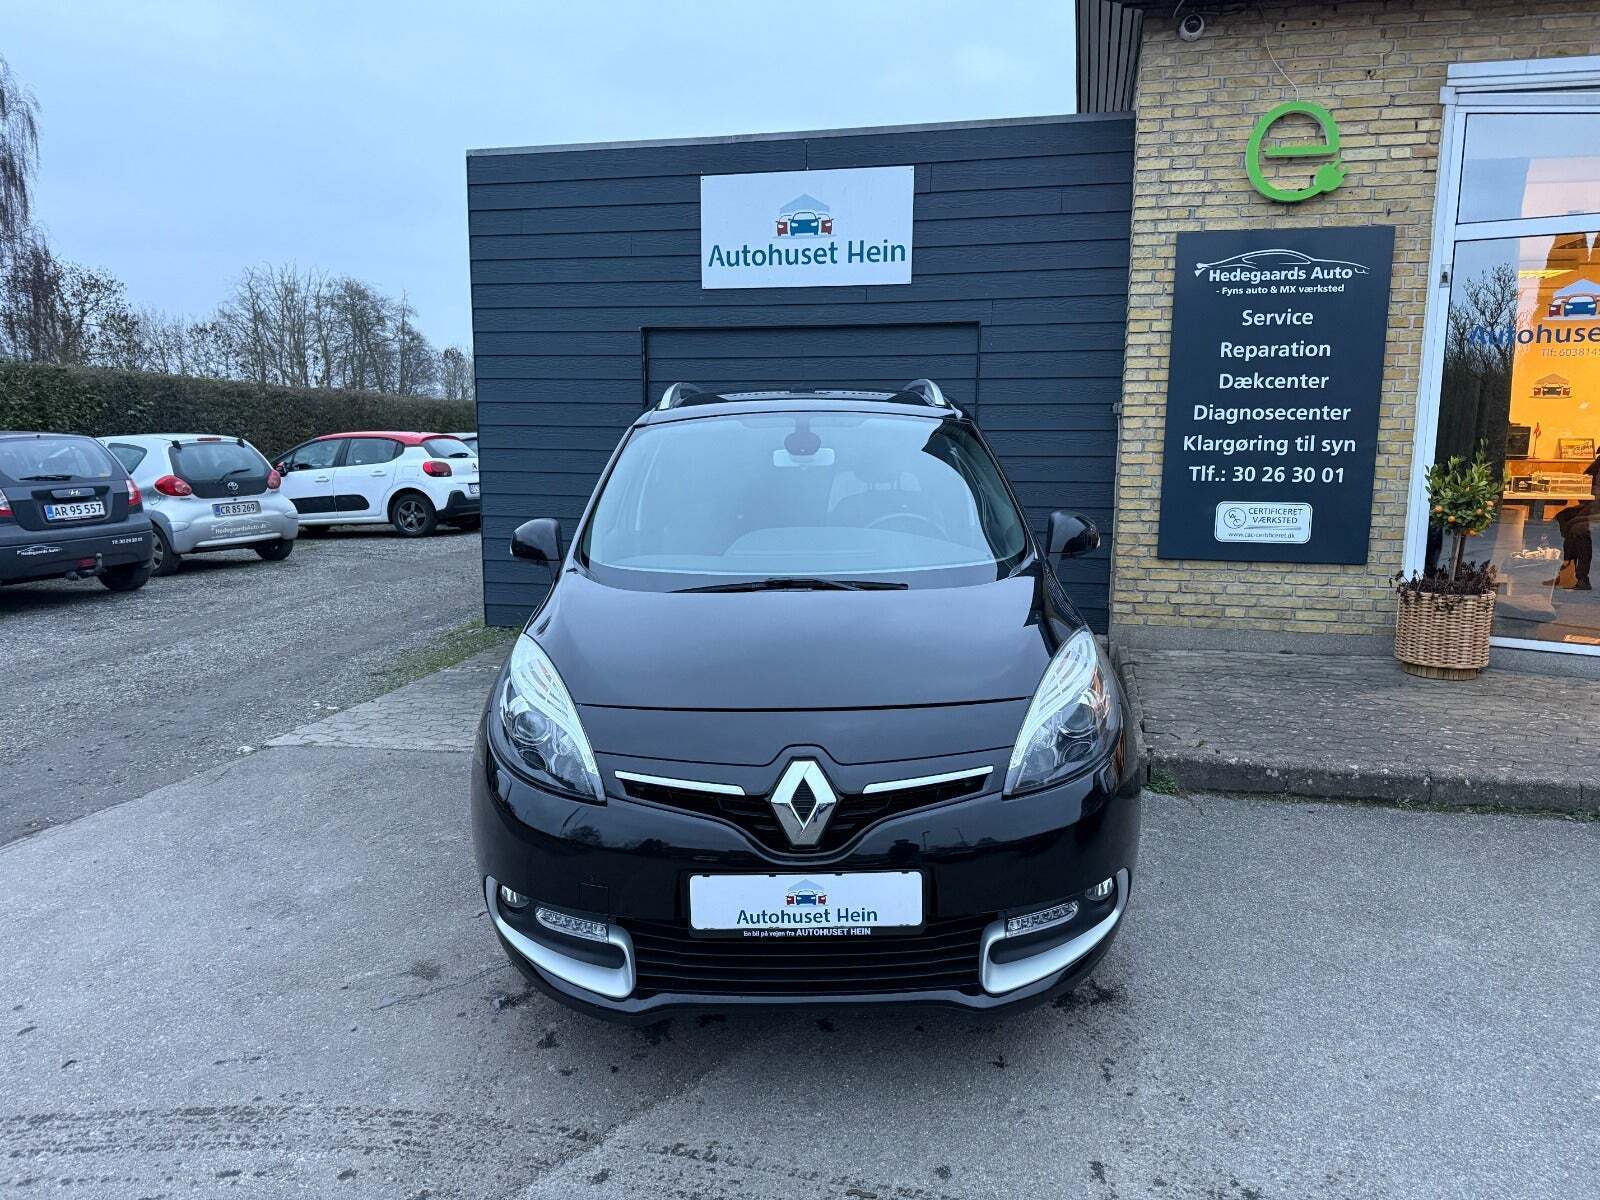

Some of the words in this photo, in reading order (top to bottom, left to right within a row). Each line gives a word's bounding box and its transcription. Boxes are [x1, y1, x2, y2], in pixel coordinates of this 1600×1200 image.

[708, 241, 838, 267] Autohuset
[848, 239, 906, 264] Hein
[1209, 266, 1306, 284] Hedegaards
[1311, 266, 1353, 280] Auto
[1222, 286, 1243, 296] Fyns
[1246, 286, 1268, 294] auto
[1270, 286, 1278, 294] &
[1280, 285, 1296, 293] MX
[1299, 284, 1344, 293] værksted
[1242, 308, 1314, 326] Service
[1220, 340, 1331, 361] Reparation
[1219, 372, 1330, 389] Dækcenter
[1193, 404, 1352, 424] Diagnosecenter
[1183, 435, 1289, 455] Klargøring
[1295, 436, 1315, 452] til
[1321, 438, 1356, 455] syn
[1189, 465, 1226, 482] Tlf.:
[1232, 466, 1256, 482] 30
[1261, 467, 1285, 483] 26
[1291, 467, 1315, 483] 30
[1321, 467, 1344, 483] 01
[55, 506, 68, 516] AR
[70, 505, 82, 515] 95
[84, 503, 102, 514] 557
[220, 506, 231, 515] CR
[1248, 507, 1303, 516] CERTIFICERET
[1252, 516, 1298, 524] VÆRKSTED
[736, 908, 831, 925] Autohuset
[837, 908, 878, 923] Hein
[761, 930, 768, 938] på
[769, 930, 785, 938] vejen
[796, 928, 849, 937] AUTOHUSET
[850, 927, 871, 936] HEIN
